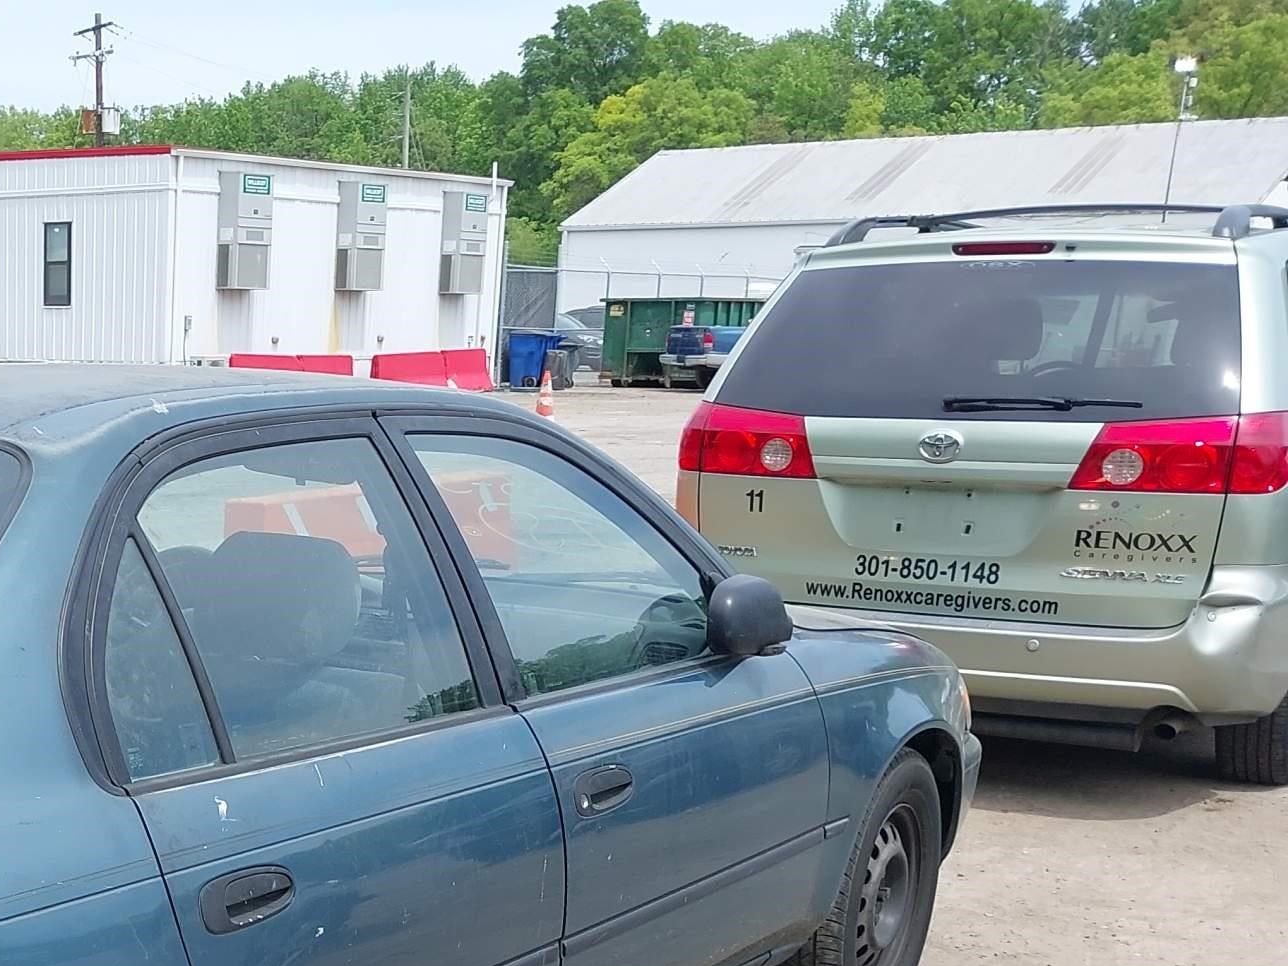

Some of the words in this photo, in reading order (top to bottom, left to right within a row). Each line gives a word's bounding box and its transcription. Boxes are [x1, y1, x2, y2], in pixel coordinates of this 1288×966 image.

[745, 489, 764, 513] 11
[1073, 529, 1199, 554] RENOXX
[1073, 549, 1198, 564] Caregivers
[854, 554, 1001, 585] 301-850-1148
[805, 581, 1060, 616] www.Renoxxcaregivers.com
